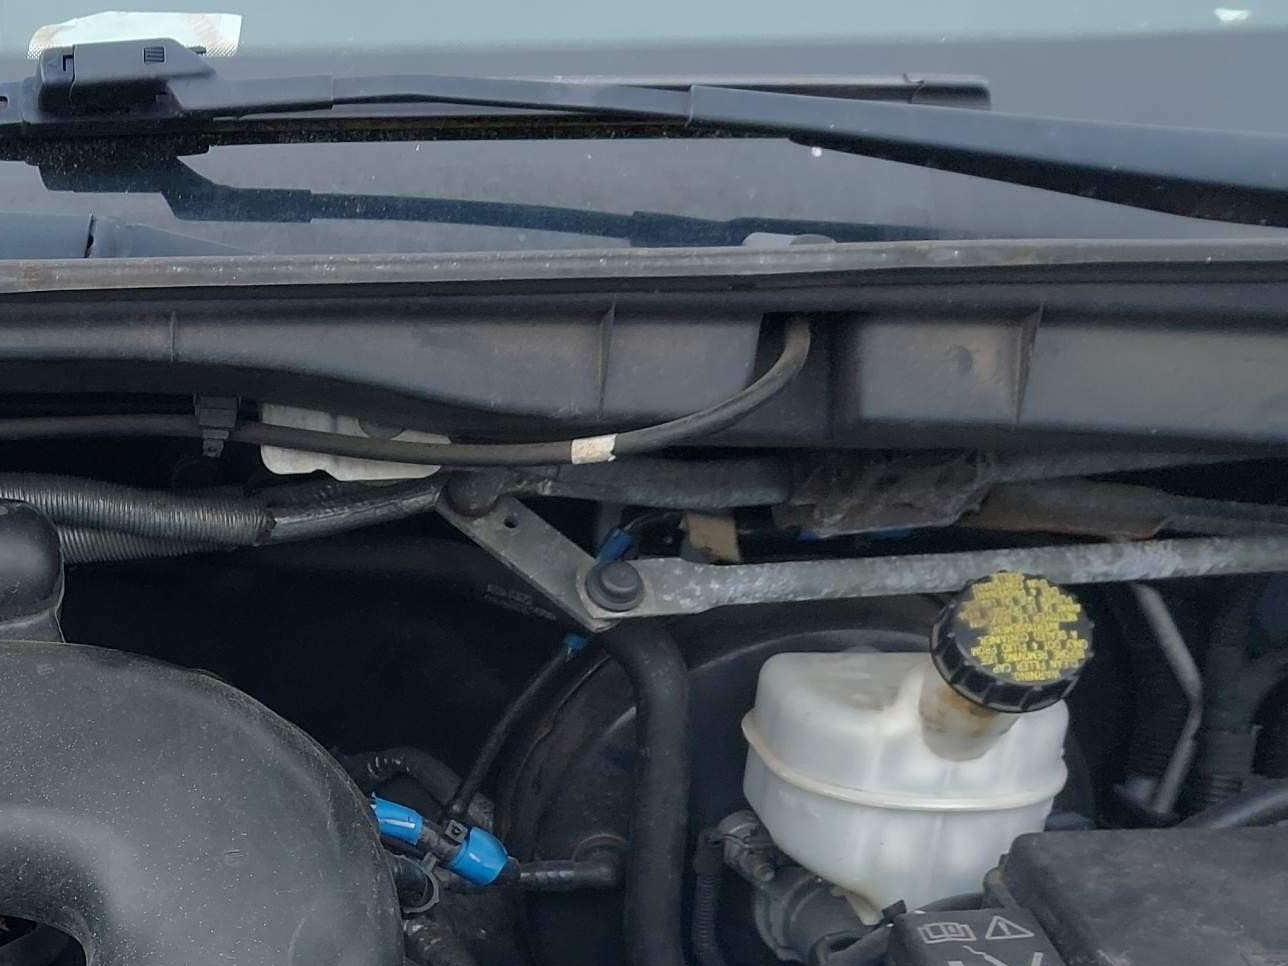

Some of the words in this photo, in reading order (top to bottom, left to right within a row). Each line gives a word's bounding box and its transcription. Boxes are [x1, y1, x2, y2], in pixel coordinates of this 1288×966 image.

[971, 646, 997, 656] FROM
[993, 663, 1011, 673] CAP
[1016, 661, 1046, 671] FILLER
[1014, 670, 1061, 681] WARNING
